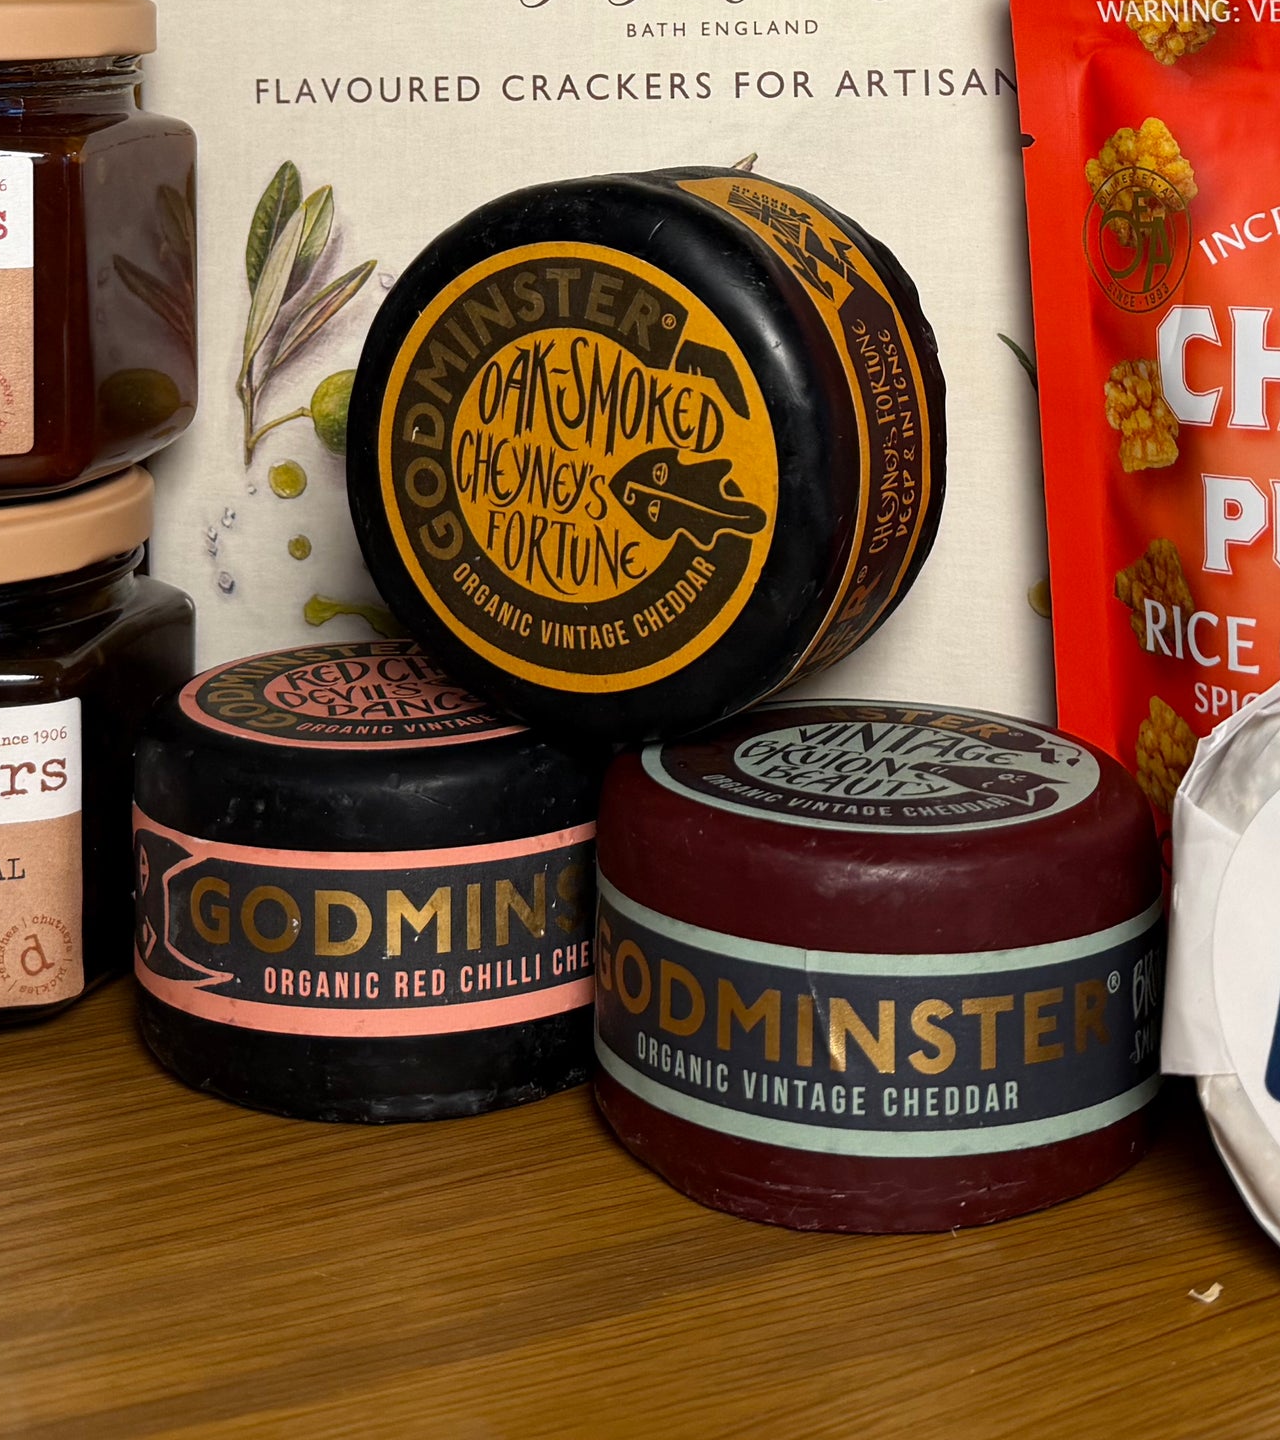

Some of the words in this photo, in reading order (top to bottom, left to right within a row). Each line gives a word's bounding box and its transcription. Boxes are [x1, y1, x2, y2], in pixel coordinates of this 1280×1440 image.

[626, 22, 689, 40] BATH
[700, 19, 820, 38] ENGLAND
[255, 74, 482, 106] FLAVOURED
[501, 71, 714, 103] CRACKERS
[734, 69, 814, 100] FOR
[851, 319, 892, 425] FORTUNE
[877, 329, 915, 439] INTENSE
[478, 336, 724, 455] OAK-SMOKED
[456, 428, 610, 520] CHEYNEY'S
[903, 445, 915, 460] &
[895, 471, 915, 538] DEEP
[486, 511, 647, 594] FORTUNE
[452, 561, 532, 638] ORGANIC
[541, 620, 629, 650] VINTAGE
[635, 556, 716, 638] CHEDDAR
[1144, 598, 1259, 674] RICE
[276, 680, 420, 709] DEVIL'S
[285, 661, 370, 691] RED
[296, 722, 393, 735] ORGANIC
[405, 712, 500, 733] VINTAGE
[327, 691, 486, 718] DANCE
[33, 727, 68, 745] 1906
[798, 723, 1023, 766] VINTAGE
[703, 773, 784, 804] ORGANIC
[790, 797, 892, 816] VINTAGE
[902, 796, 1009, 818] CHEDDAR
[759, 764, 951, 799] BEAUTY
[21, 934, 55, 977] d
[264, 966, 380, 999] ORGANIC
[395, 968, 445, 999] RED
[460, 953, 540, 993] CHILLI
[552, 937, 595, 977] CHE
[637, 1031, 730, 1093] ORGANIC
[743, 1070, 866, 1115] VINTAGE
[882, 1079, 1019, 1117] CHEDDAR
